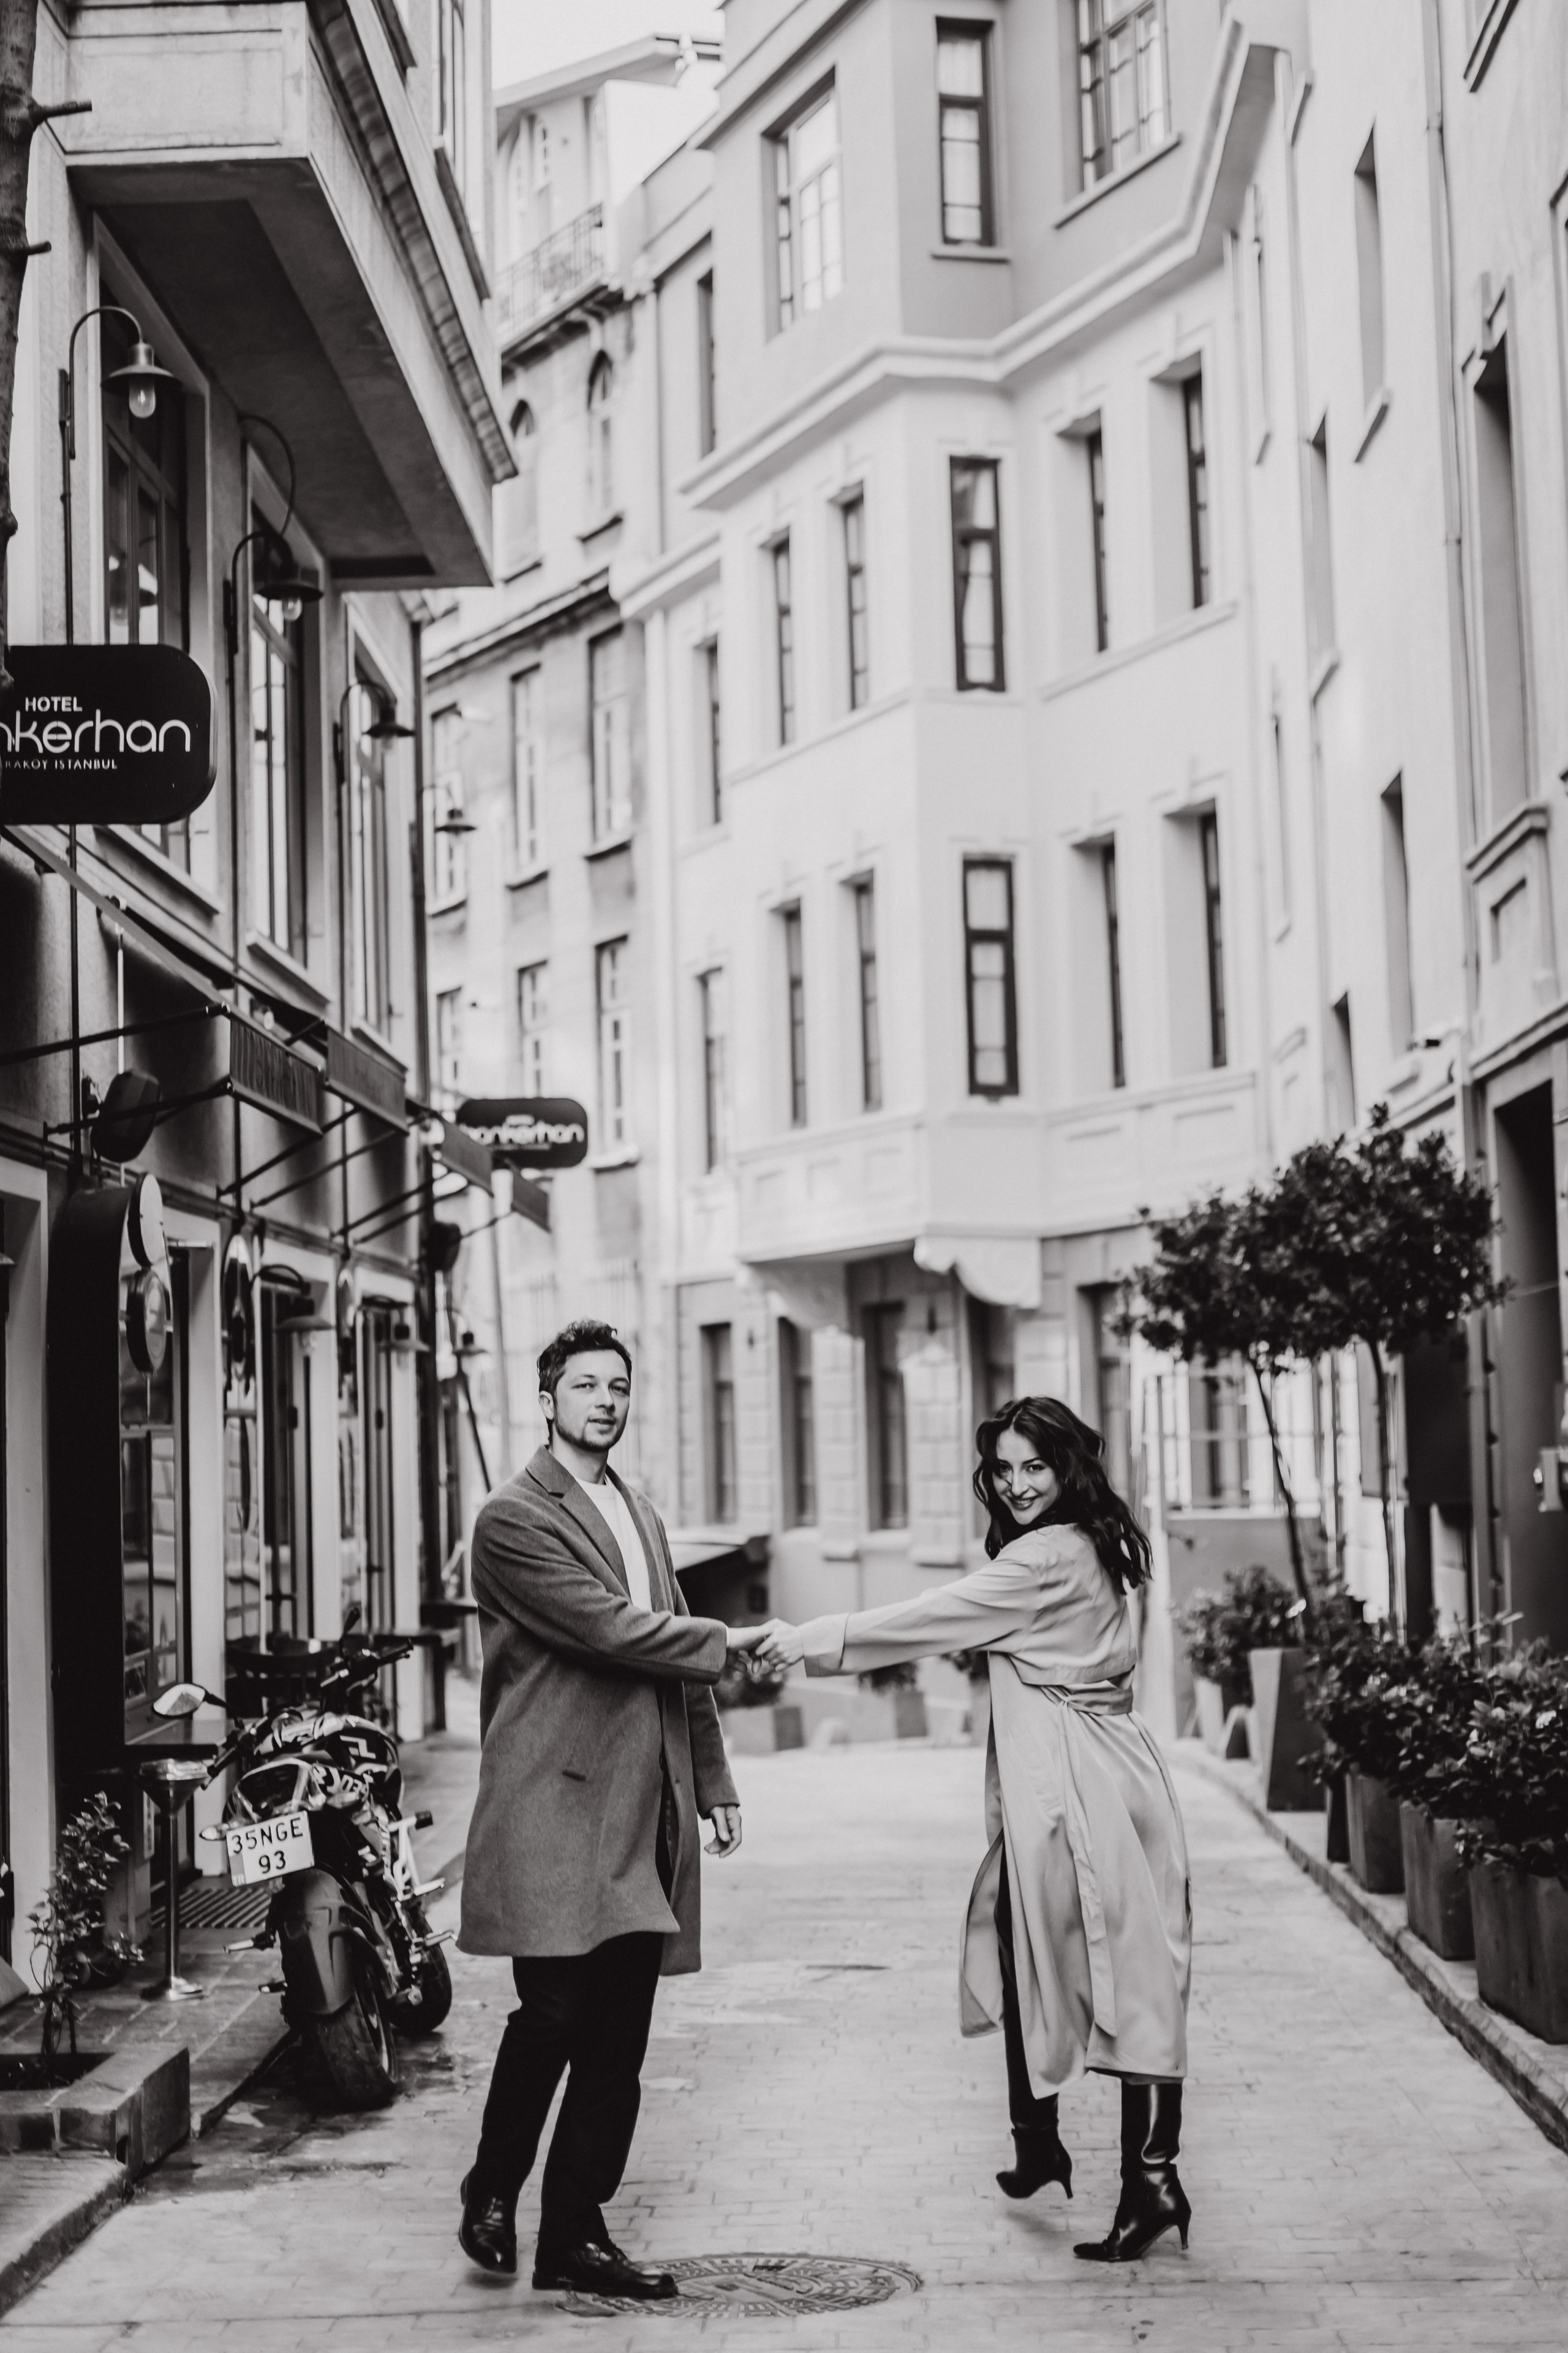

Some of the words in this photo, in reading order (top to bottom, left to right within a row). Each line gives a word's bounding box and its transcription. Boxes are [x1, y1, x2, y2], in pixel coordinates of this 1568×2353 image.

[25, 696, 83, 712] HOTEL
[232, 1817, 303, 1854] 35NGE
[258, 1851, 286, 1875] 93
